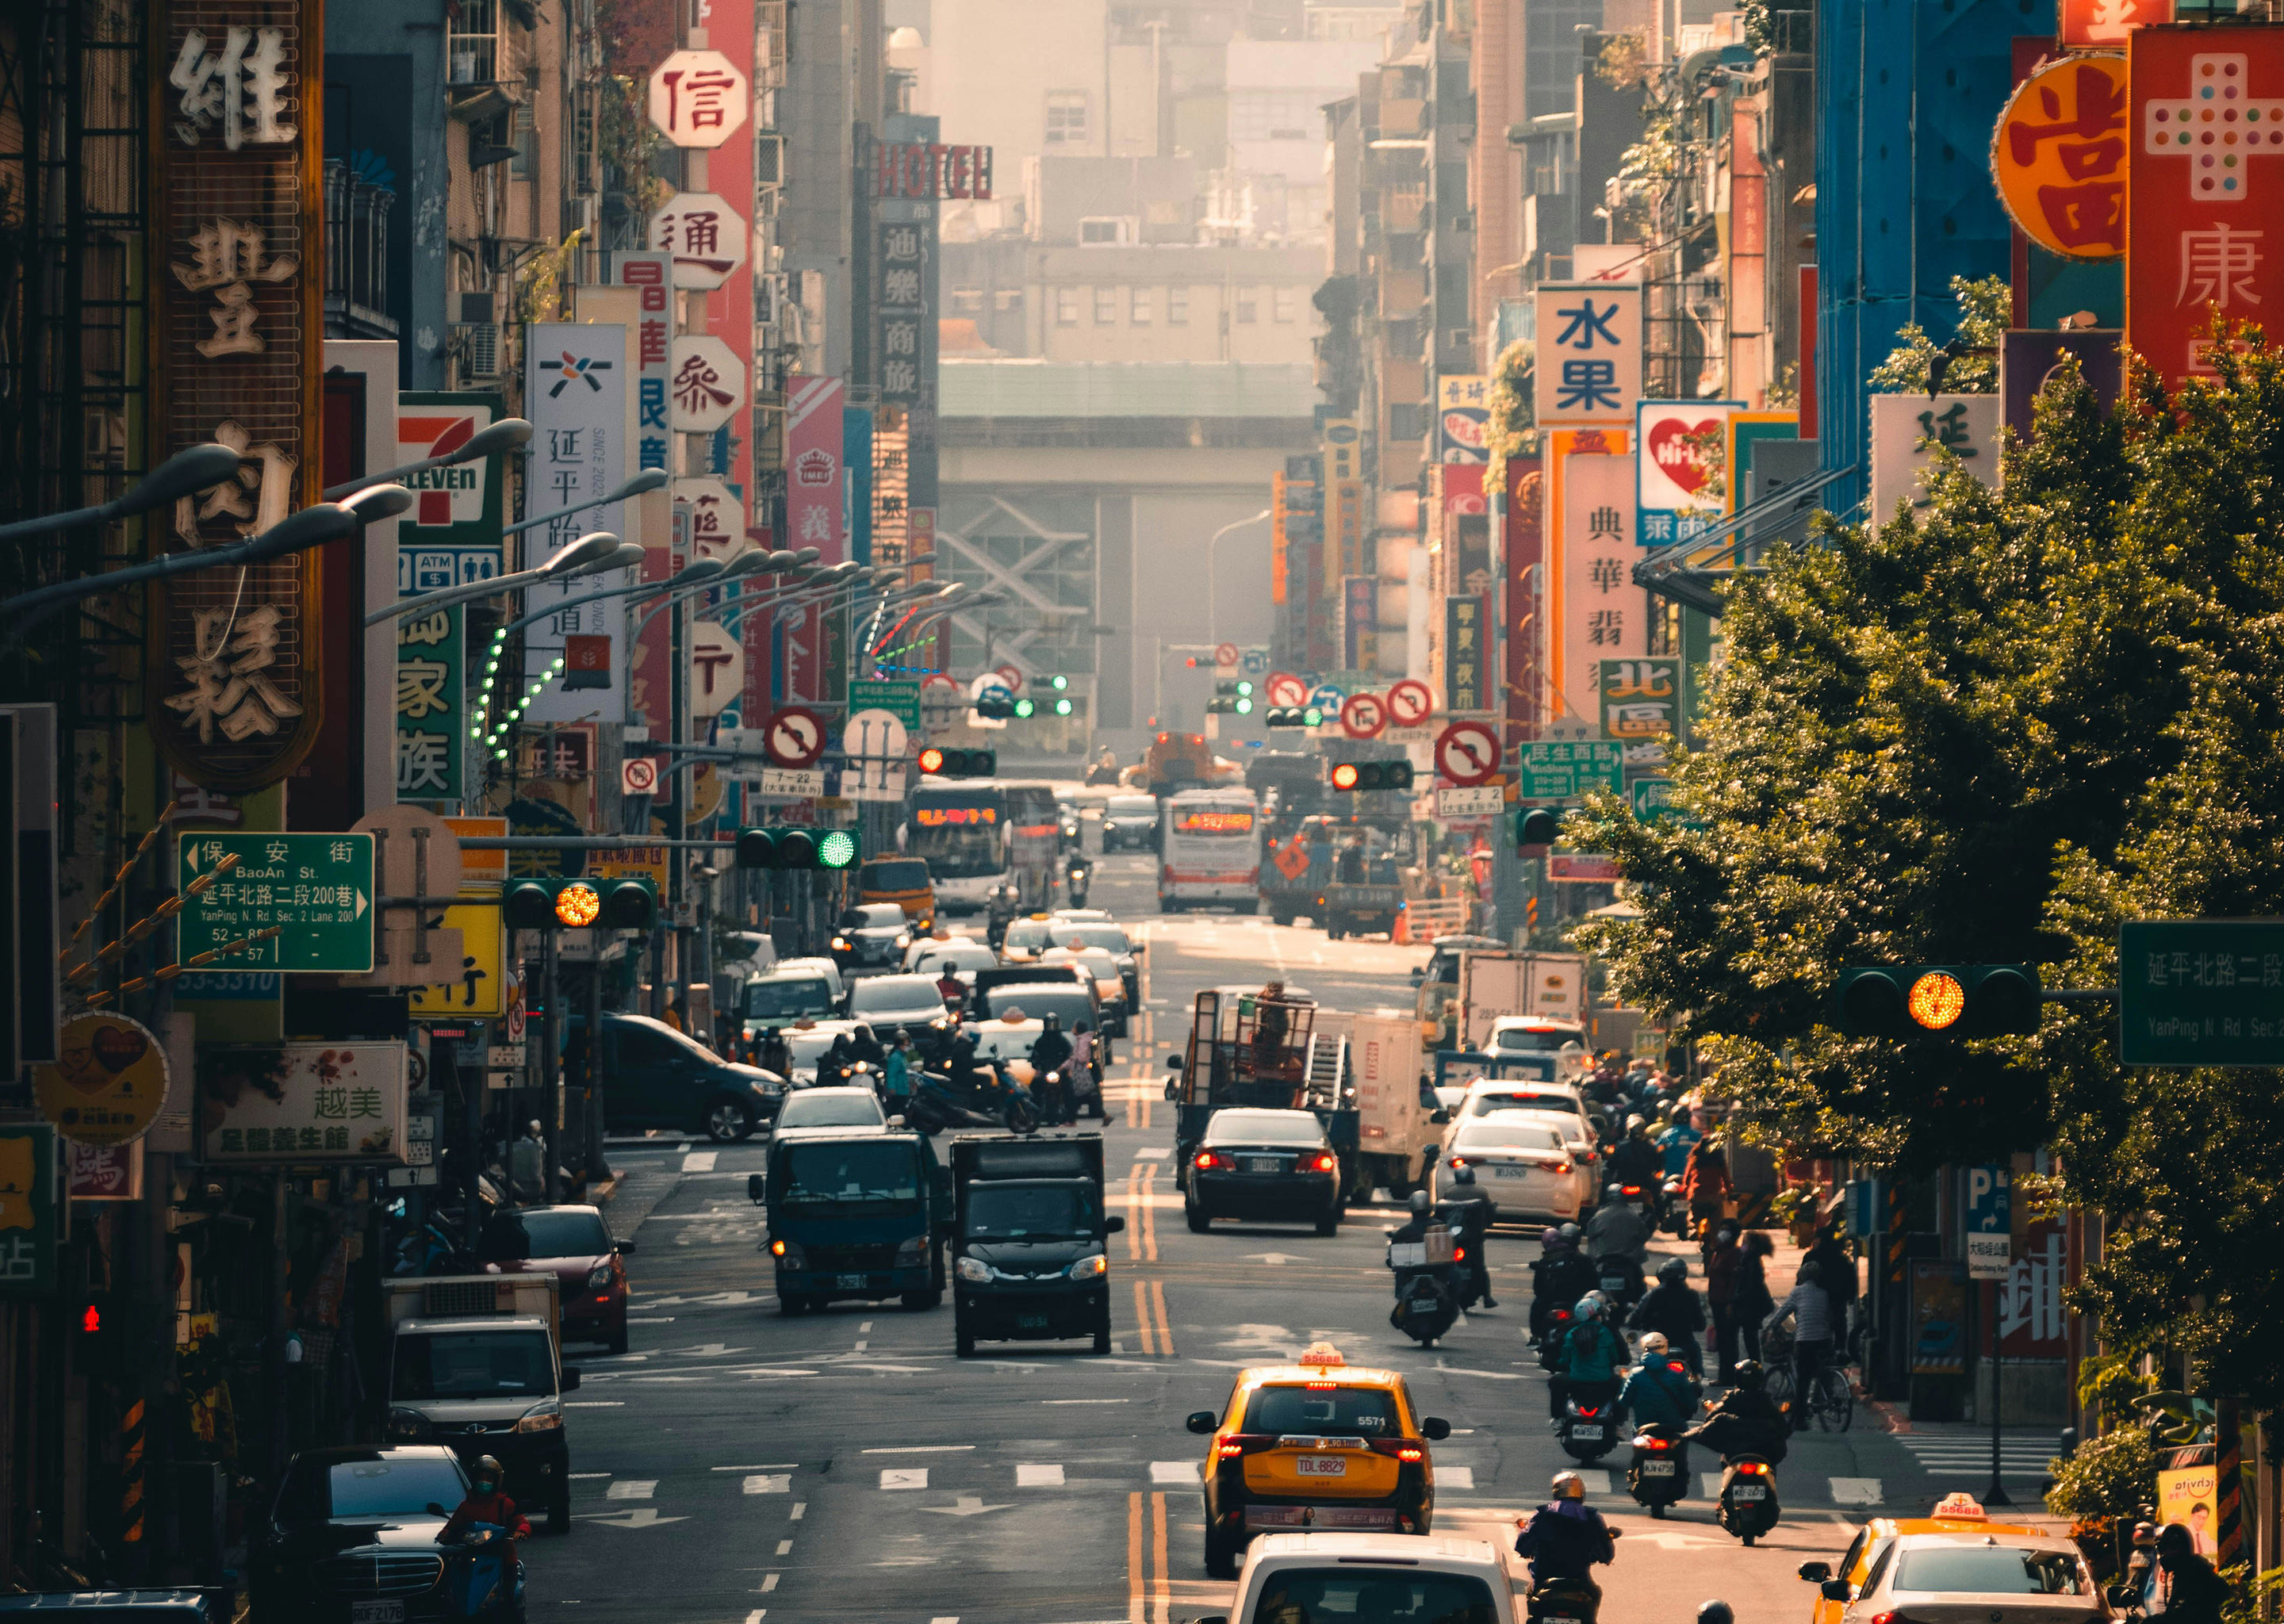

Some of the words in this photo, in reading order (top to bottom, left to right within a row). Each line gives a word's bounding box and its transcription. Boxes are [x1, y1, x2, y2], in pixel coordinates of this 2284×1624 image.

[879, 144, 991, 199] HOTEL
[1556, 298, 1622, 411] 水果
[420, 556, 450, 568] ATM
[1531, 745, 1612, 762] 民生西路
[202, 841, 354, 863] 保安街
[236, 867, 285, 879] BaoAn
[300, 867, 319, 879] St.
[201, 884, 353, 906] 延平北路二段200巷
[201, 910, 238, 924] YanPing
[243, 910, 252, 922] N.
[257, 910, 272, 922] Rd.
[277, 910, 296, 922] Sec.
[301, 910, 307, 921] 2
[312, 910, 334, 922] Lane
[338, 910, 354, 922] 200
[212, 929, 228, 941] 52
[247, 948, 264, 960] 57
[2148, 952, 2284, 987] 延平北路二段
[2148, 1017, 2199, 1041] YanPing
[314, 1086, 382, 1120] 越美
[1970, 1169, 1991, 1209] P
[1358, 1416, 1385, 1427] 5571
[1298, 1460, 1346, 1473] TDL-8829
[1940, 1505, 1980, 1515] 55688
[353, 1606, 404, 1623] RDF-2178
